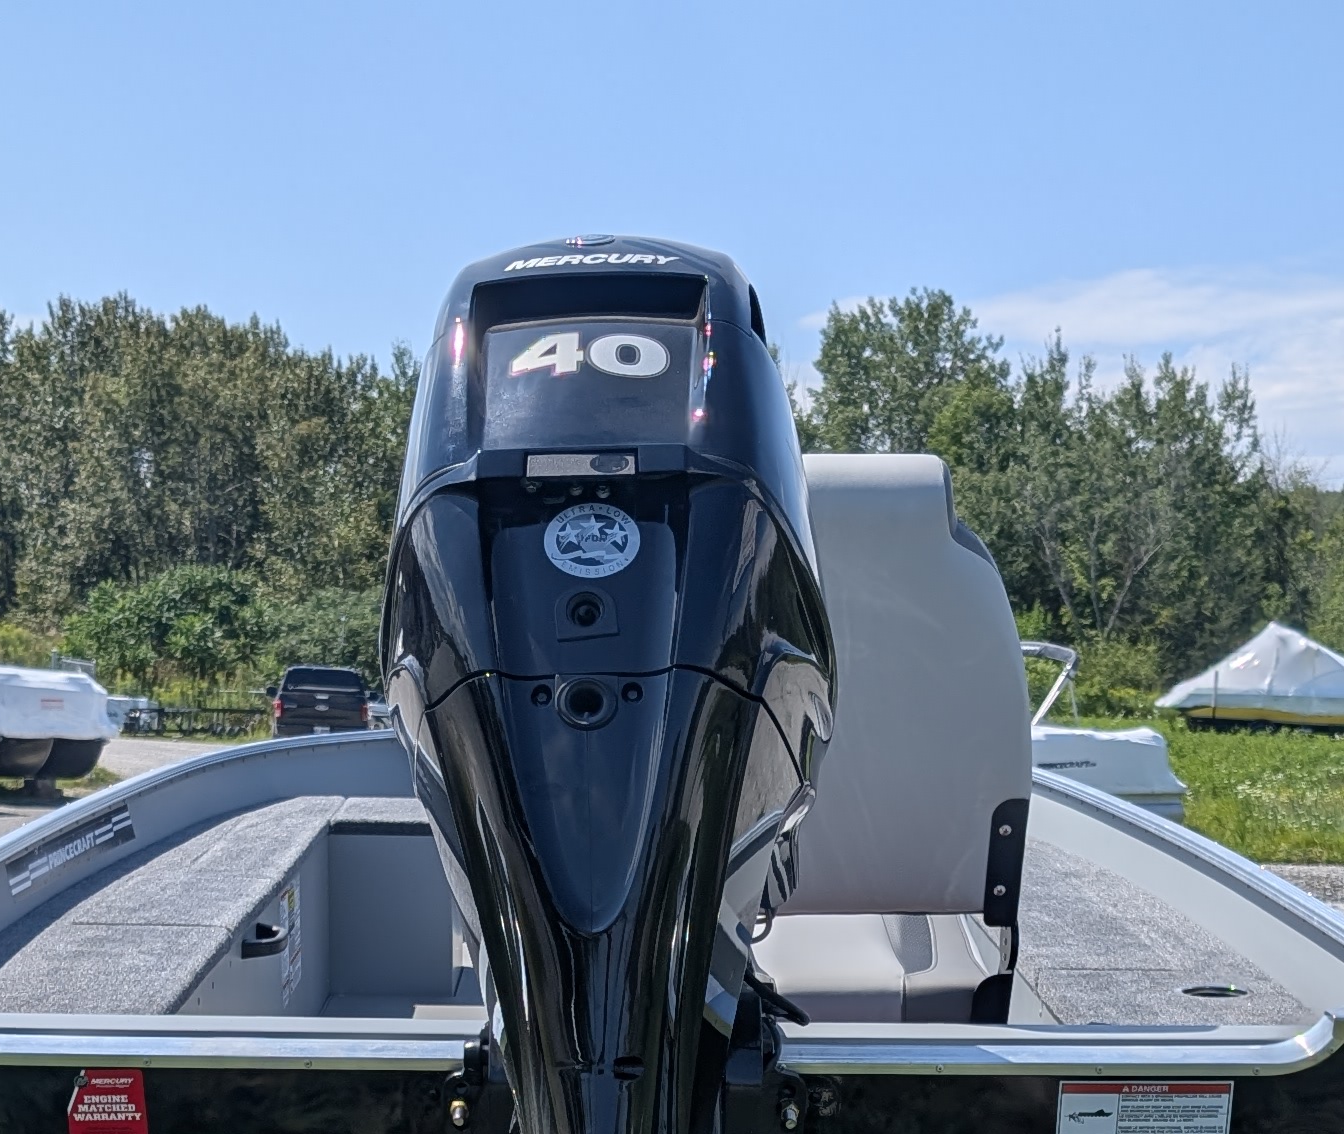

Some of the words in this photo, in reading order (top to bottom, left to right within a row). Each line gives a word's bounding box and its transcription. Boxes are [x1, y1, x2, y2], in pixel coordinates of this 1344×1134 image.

[504, 253, 680, 271] MERCURY
[509, 331, 670, 378] 40
[556, 504, 596, 524] ULTRA
[606, 506, 632, 526] LOW
[560, 560, 624, 576] EMISSION
[48, 832, 95, 870] PRINCECRAFT
[1131, 1085, 1169, 1093] DANGER
[83, 1095, 129, 1104] ENGINE
[73, 1112, 142, 1121] WARRANTY
[77, 1104, 136, 1113] MATCHED
